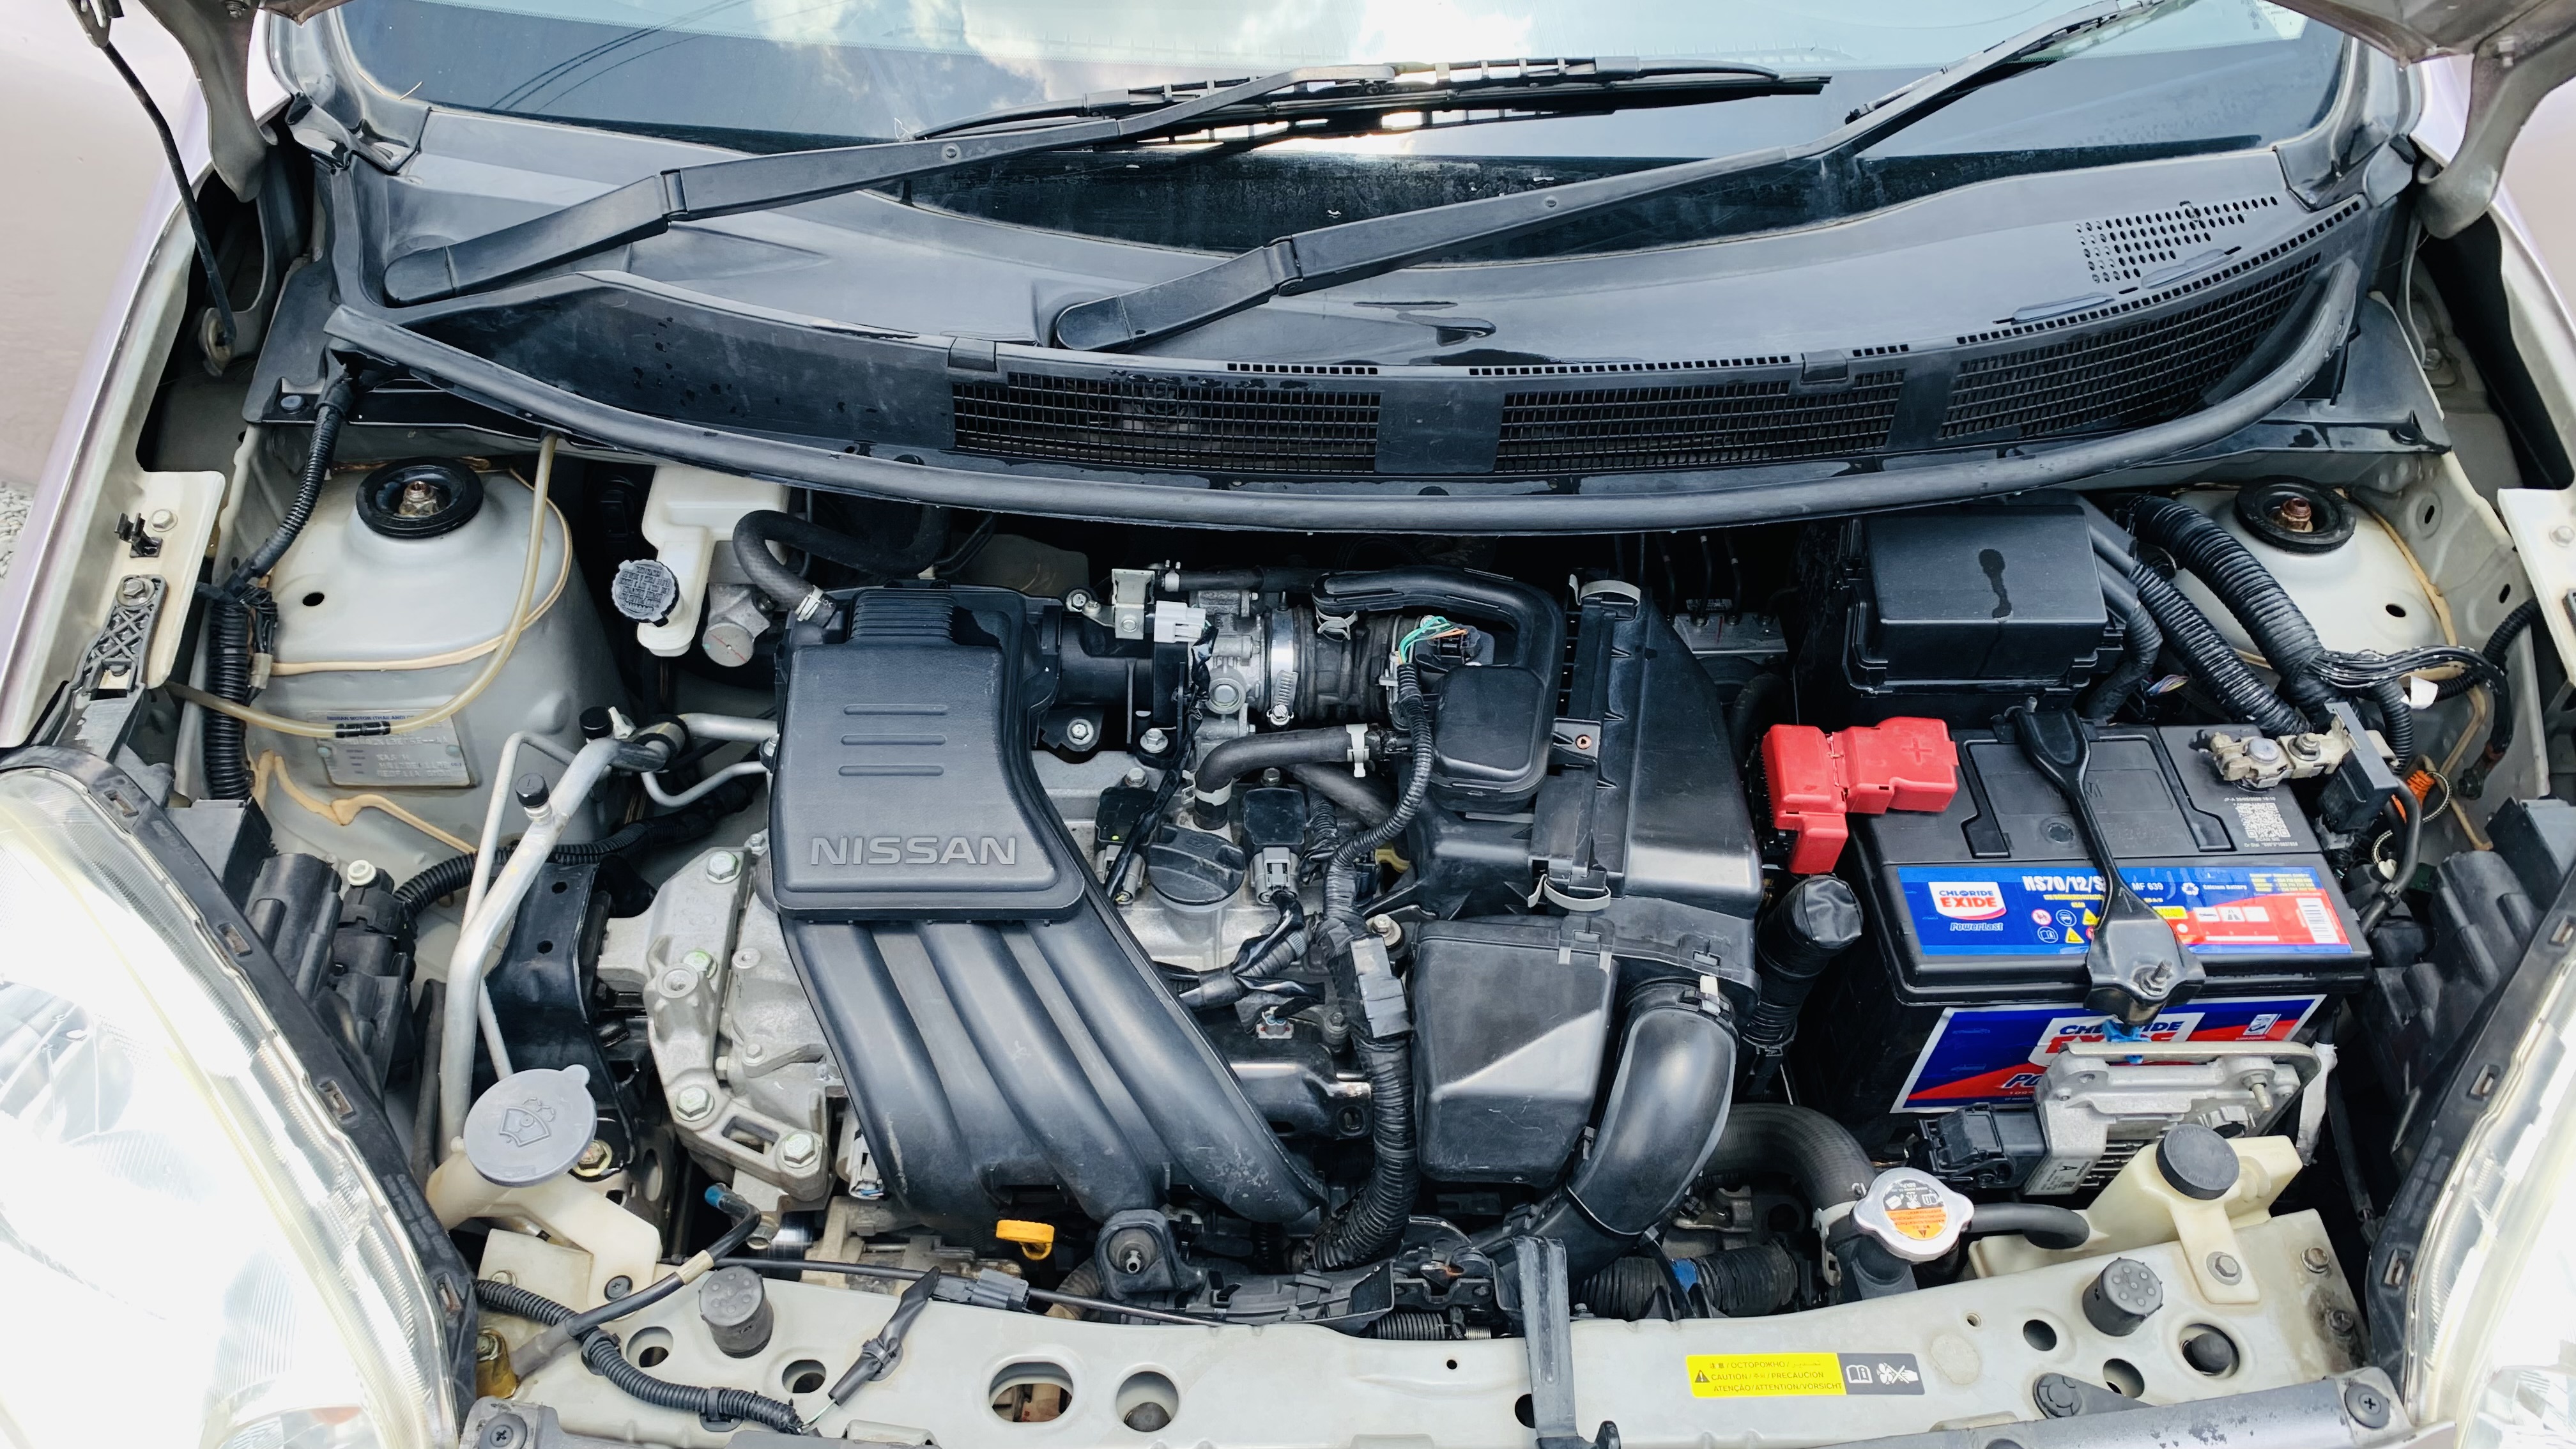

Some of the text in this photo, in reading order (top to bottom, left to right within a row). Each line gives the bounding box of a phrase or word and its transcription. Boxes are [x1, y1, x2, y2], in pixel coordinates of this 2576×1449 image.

[810, 836, 1016, 865] NISSAN
[2131, 882, 2164, 891] MF 639
[1940, 897, 1998, 908] EXIDE
